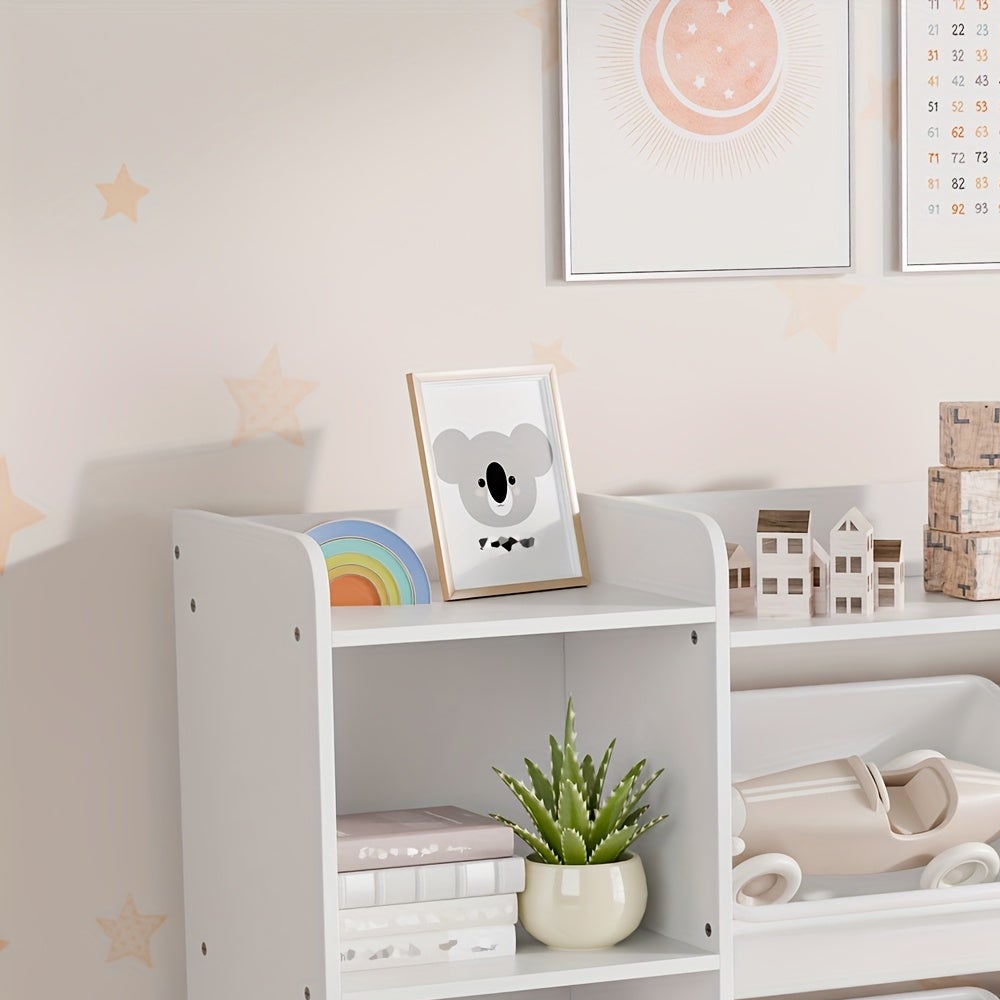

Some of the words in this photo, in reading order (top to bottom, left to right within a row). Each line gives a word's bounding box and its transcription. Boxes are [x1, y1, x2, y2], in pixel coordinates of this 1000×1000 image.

[927, 0, 940, 10] 11
[952, 0, 966, 11] 12
[976, 0, 989, 11] 13
[927, 23, 939, 36] 21
[951, 23, 965, 36] 22
[976, 23, 989, 37] 23
[927, 49, 939, 62] 31
[951, 48, 965, 62] 32
[975, 48, 989, 63] 33
[927, 75, 940, 87] 41
[951, 74, 966, 87] 42
[974, 74, 989, 87] 43
[928, 100, 939, 113] 51
[951, 100, 964, 113] 52
[975, 100, 988, 113] 53
[927, 126, 940, 139] 61
[951, 125, 965, 139] 62
[974, 124, 989, 139] 63
[928, 152, 940, 164] 71
[951, 151, 966, 164] 72
[975, 150, 989, 164] 73
[927, 177, 940, 190] 81
[951, 176, 966, 190] 82
[975, 175, 989, 190] 83
[927, 203, 940, 215] 91
[951, 203, 966, 216] 92
[974, 202, 989, 215] 93
